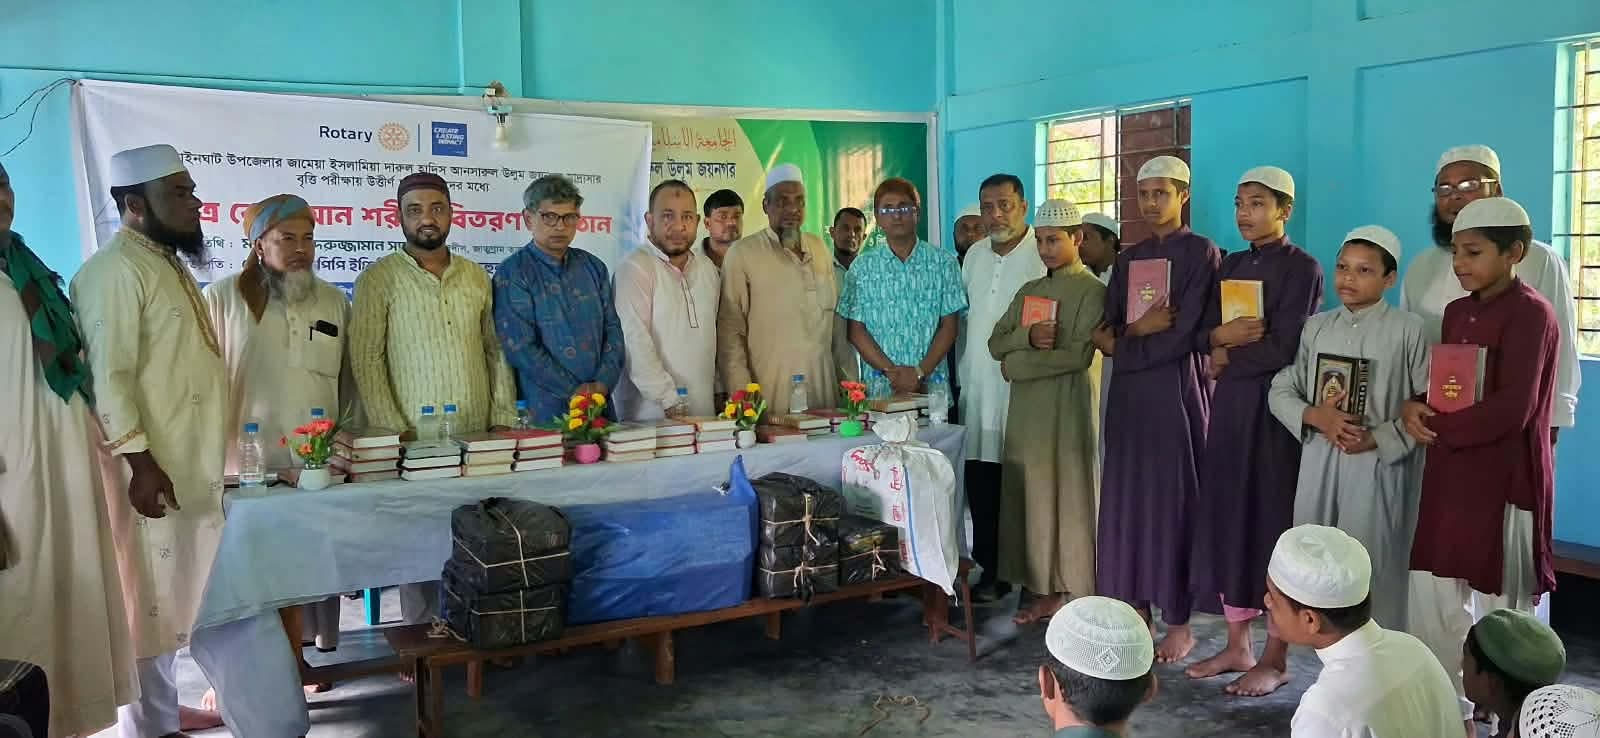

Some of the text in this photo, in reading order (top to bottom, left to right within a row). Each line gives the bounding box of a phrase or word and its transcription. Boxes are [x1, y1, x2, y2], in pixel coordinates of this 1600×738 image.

[319, 125, 373, 143] Rotary
[435, 133, 465, 141] LASTING
[180, 152, 222, 165] াইনঘাট
[226, 152, 282, 168] উপজেলার
[287, 158, 325, 170] জামেয়া
[329, 158, 380, 173] ইসলামিয়া
[384, 163, 414, 174] দারুল
[450, 165, 499, 179] আনসারুল
[696, 161, 737, 179] জয়নগর
[296, 172, 318, 189] বৃত্তি
[321, 173, 362, 187] পরীক্ষায়
[467, 182, 491, 193] মধ্যে
[317, 256, 347, 271] পিপি
